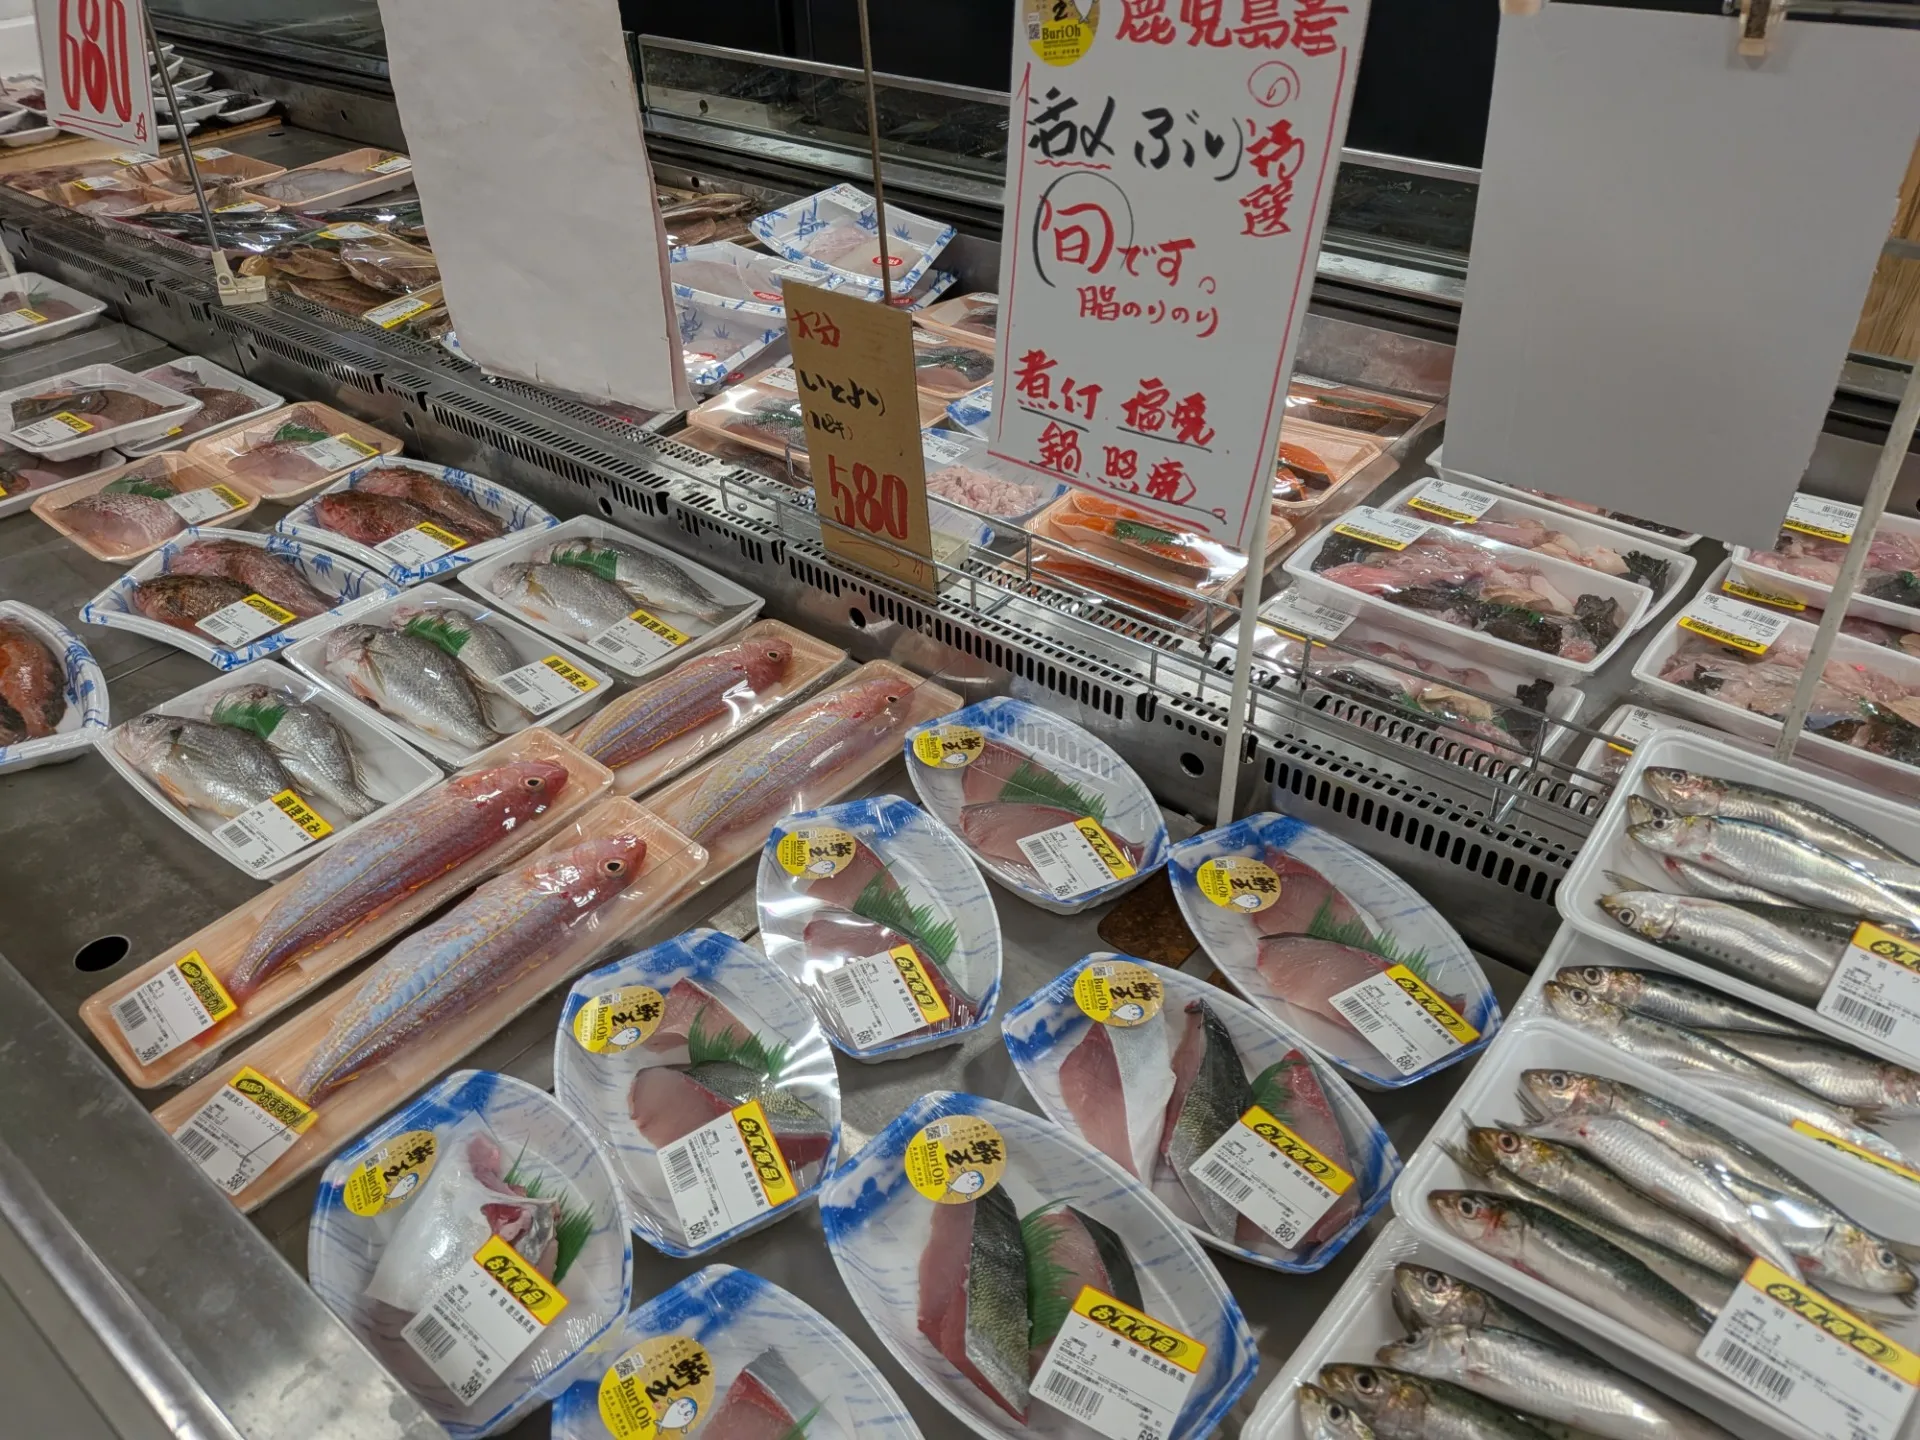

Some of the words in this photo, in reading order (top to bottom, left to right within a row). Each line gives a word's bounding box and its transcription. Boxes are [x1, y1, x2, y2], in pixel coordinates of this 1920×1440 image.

[1116, 0, 1348, 57] 鹿児島産
[59, 0, 132, 122] 680
[1077, 286, 1219, 337] 脂のりのり
[828, 454, 908, 540] 580
[275, 789, 322, 840] 調理済み
[1395, 1052, 1415, 1072] 680
[736, 1113, 783, 1185] お買得品
[926, 1141, 945, 1186] BuriOh
[1252, 1117, 1330, 1178] お買得品
[362, 1166, 387, 1203] BuriOh
[687, 1220, 708, 1240] 680
[1273, 1222, 1297, 1244] 880
[482, 1248, 545, 1312] お買得品
[1087, 1298, 1180, 1359] お買得品
[459, 1374, 482, 1398] 398
[619, 1377, 652, 1429] BuriOh
